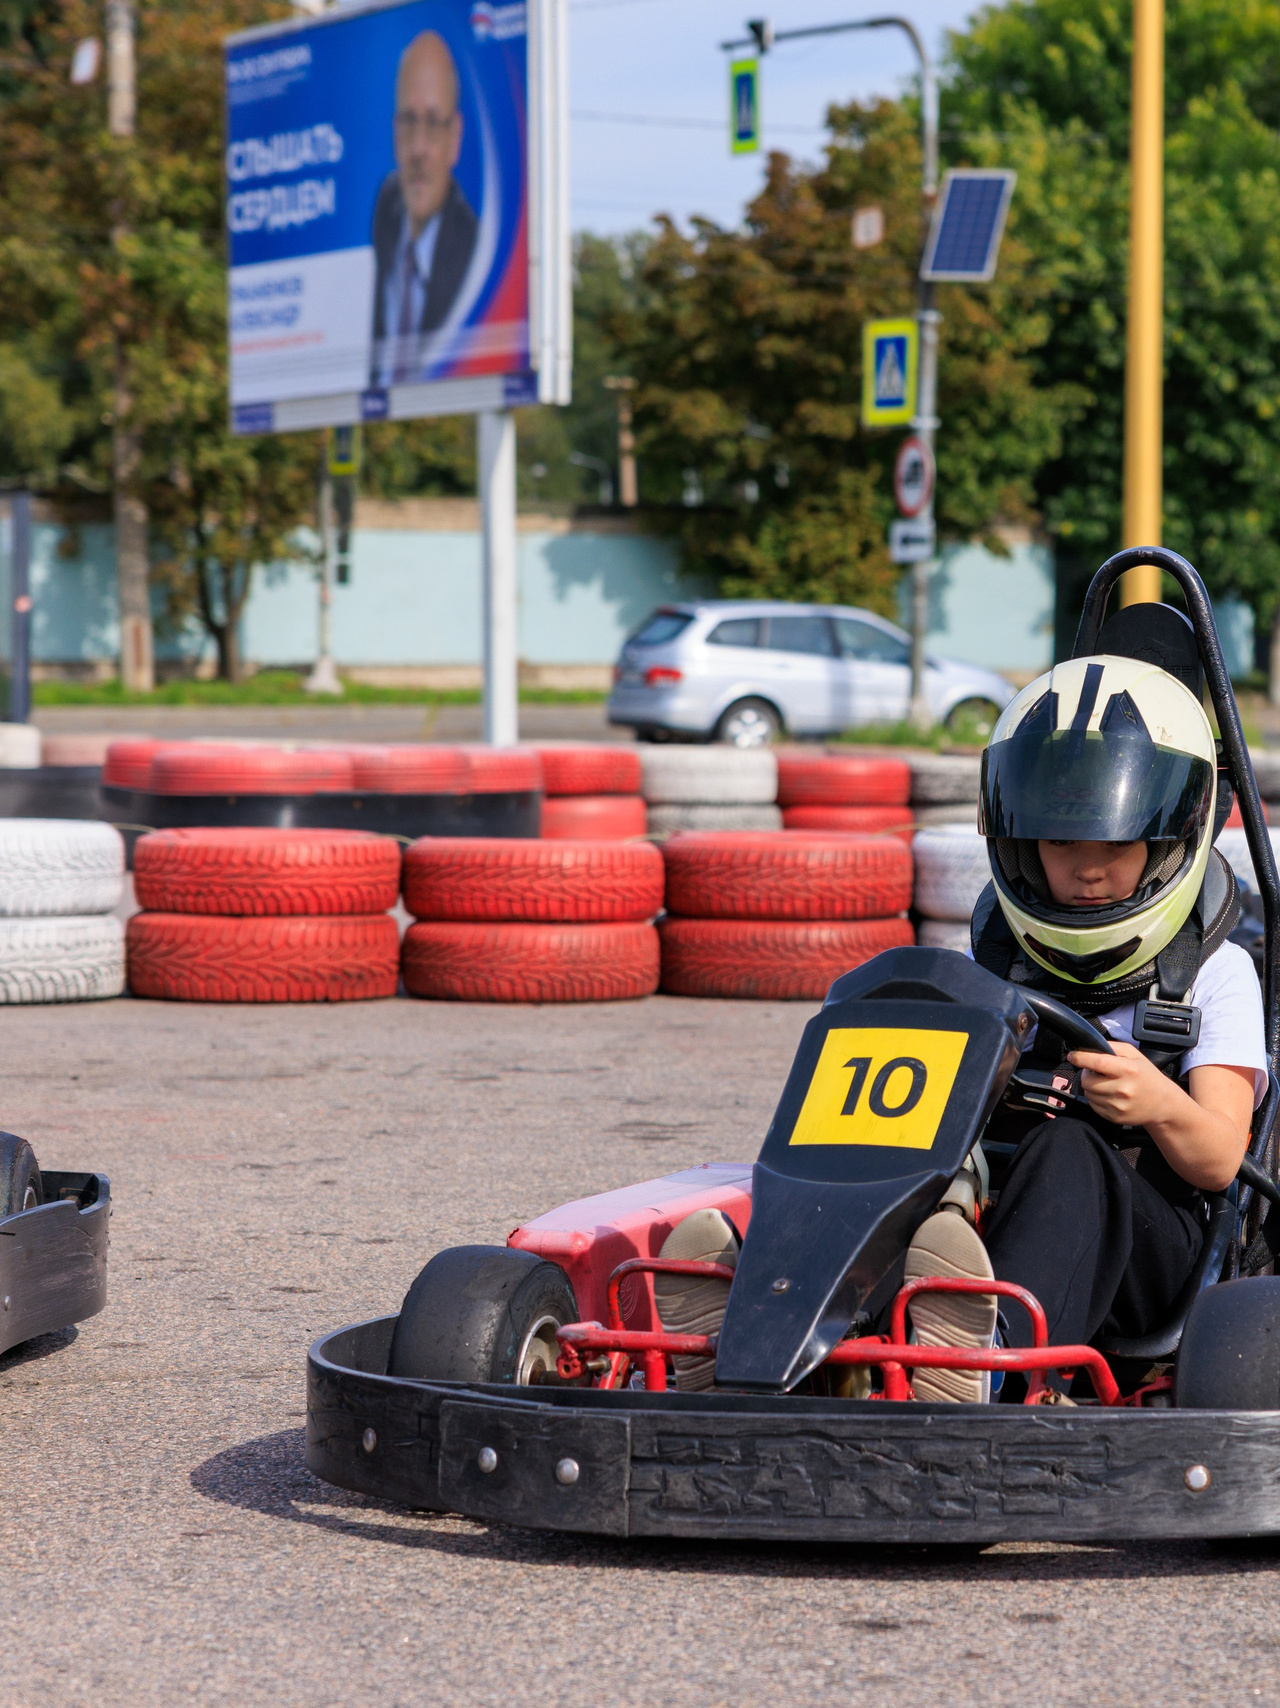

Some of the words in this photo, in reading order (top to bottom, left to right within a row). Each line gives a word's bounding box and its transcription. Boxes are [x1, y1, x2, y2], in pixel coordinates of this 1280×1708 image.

[226, 124, 344, 181] СЛЫШАТЬ
[226, 179, 335, 233] СЕРДЦЕМ
[840, 1056, 928, 1118] 10
